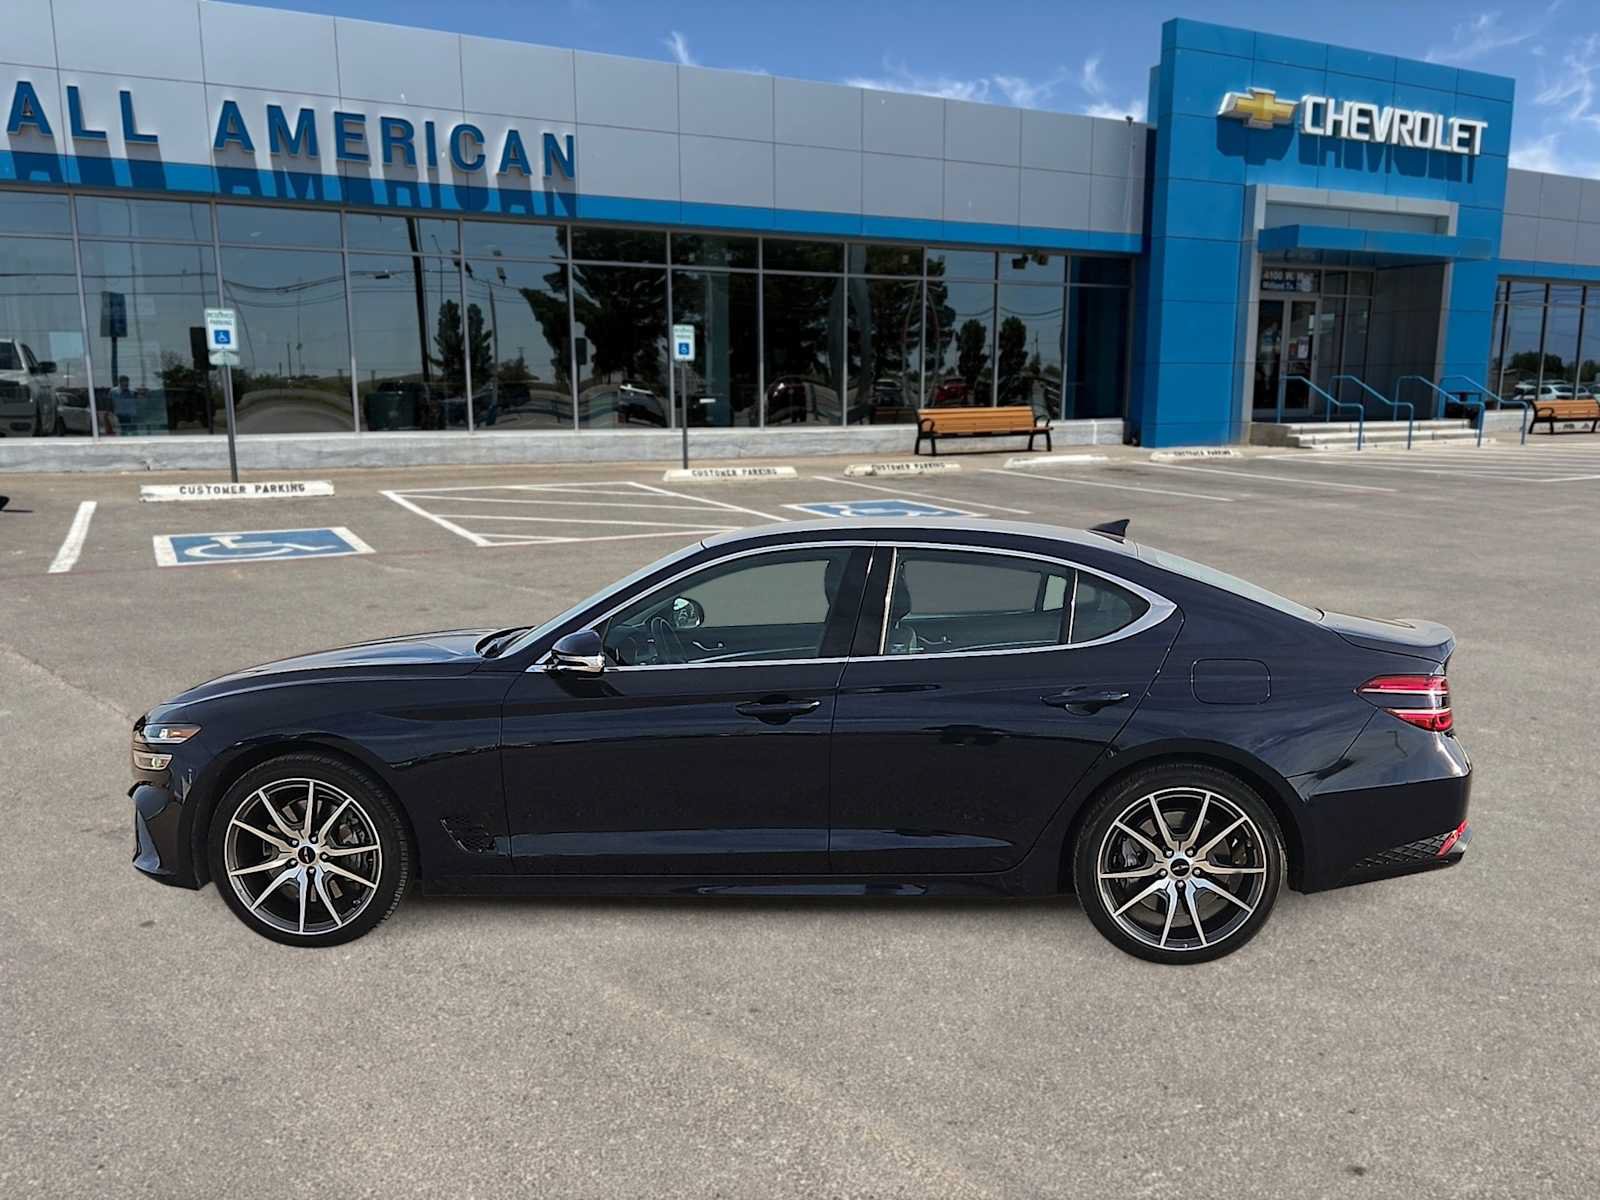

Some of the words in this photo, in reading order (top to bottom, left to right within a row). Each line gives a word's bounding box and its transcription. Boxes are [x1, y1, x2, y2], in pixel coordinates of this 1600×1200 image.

[6, 80, 158, 144] ALL
[214, 100, 576, 178] AMERICAN
[1302, 94, 1488, 155] CHEVROLET
[179, 484, 246, 495] CUSTOMER
[255, 483, 306, 493] PARKING
[692, 469, 737, 477] CUSTOMER
[742, 467, 778, 476] PARKING
